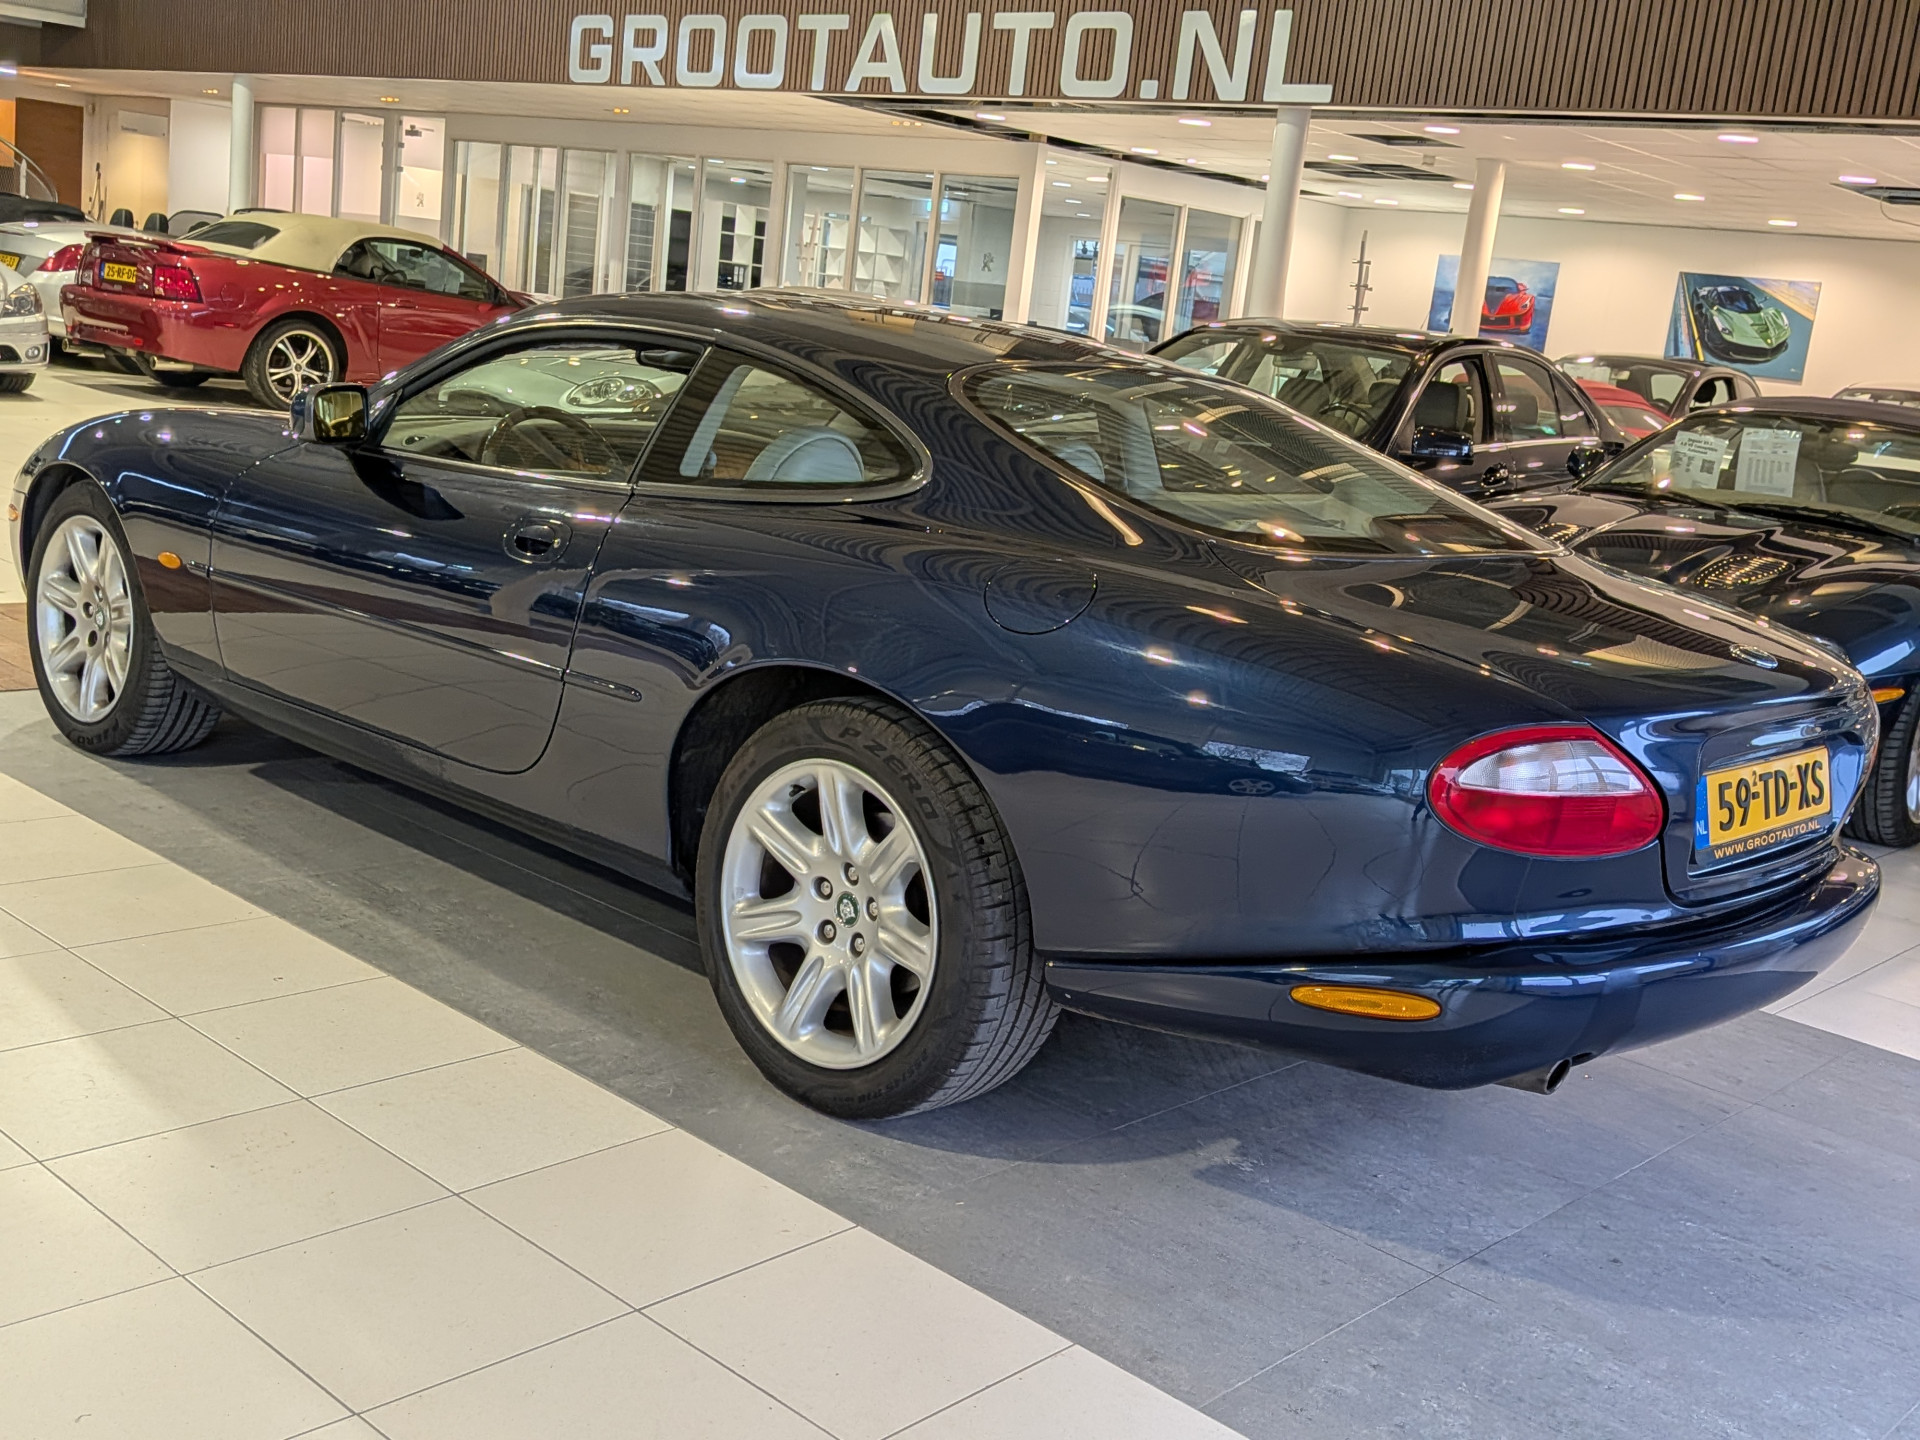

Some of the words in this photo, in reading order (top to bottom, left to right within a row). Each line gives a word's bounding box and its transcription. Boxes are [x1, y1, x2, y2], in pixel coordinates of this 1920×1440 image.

[569, 9, 1334, 104] GROOTAUTO.NL
[838, 726, 863, 740] P
[862, 739, 939, 820] ZERO
[1717, 759, 1825, 832] 59-TD-XS
[1696, 819, 1708, 836] NL
[1713, 819, 1821, 860] WWW.GROOTAUTO.NL
